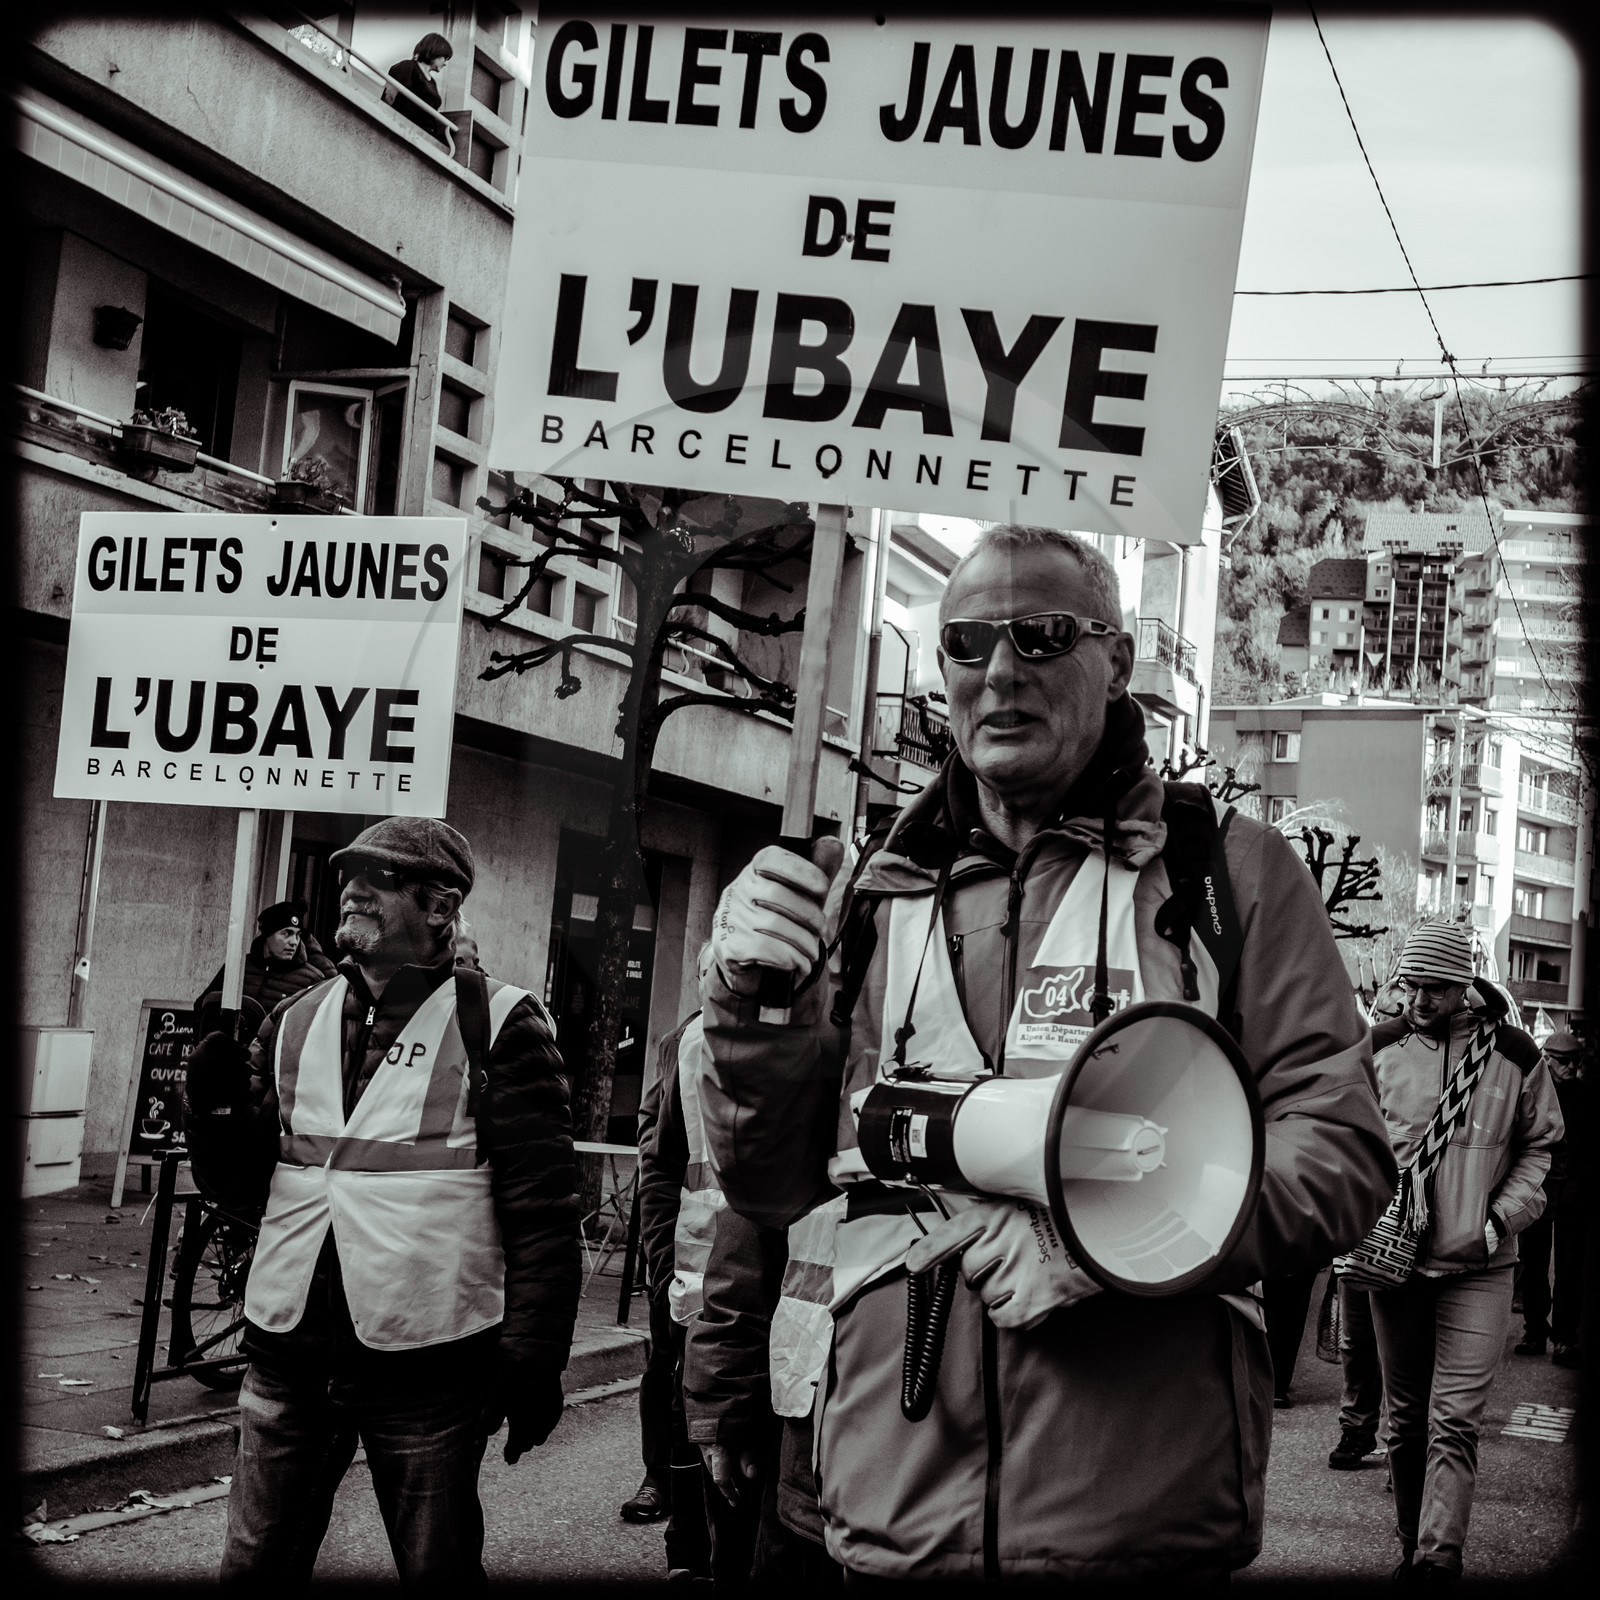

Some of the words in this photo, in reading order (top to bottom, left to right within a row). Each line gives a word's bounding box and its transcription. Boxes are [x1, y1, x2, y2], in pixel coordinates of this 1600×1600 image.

[545, 20, 831, 134] GILETS
[880, 42, 1230, 163] JAUNES
[801, 194, 896, 263] DE
[546, 272, 1159, 457] L'UBAYE
[540, 414, 1137, 507] BARCELONNETTE
[87, 535, 245, 595] GILETS
[266, 540, 450, 602] JAUNES
[228, 625, 279, 664] DE
[89, 676, 420, 764] L'UBAYE
[86, 757, 413, 792] BARCELONNETTE
[1045, 985, 1068, 1008] 04
[1020, 1034, 1043, 1042] Alpes
